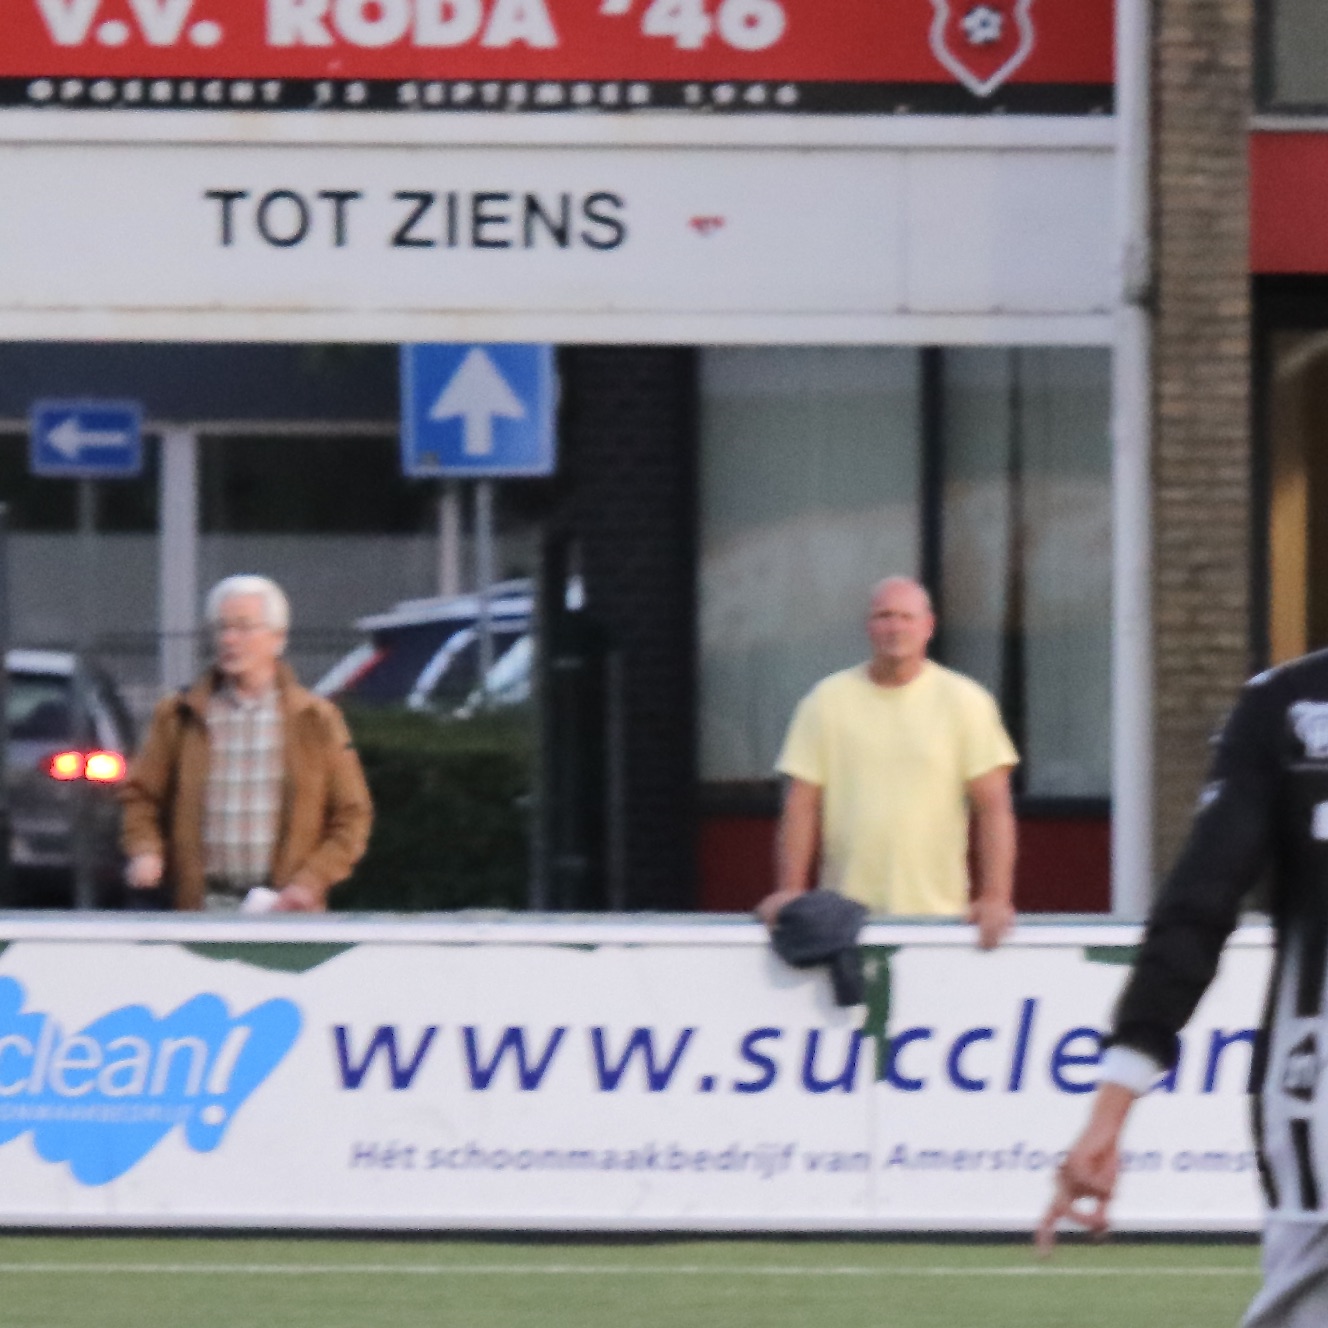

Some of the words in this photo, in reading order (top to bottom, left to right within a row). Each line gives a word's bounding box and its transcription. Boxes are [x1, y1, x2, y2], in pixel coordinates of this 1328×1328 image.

[35, 0, 222, 47] V.V.
[265, 0, 559, 49] RODA
[204, 189, 364, 248] TOT
[389, 190, 627, 250] ZIENS
[333, 998, 1258, 1094] www.succlen
[349, 1140, 416, 1171] Hét
[425, 1141, 796, 1180] schoonmaakbedrijf
[806, 1149, 871, 1172] van
